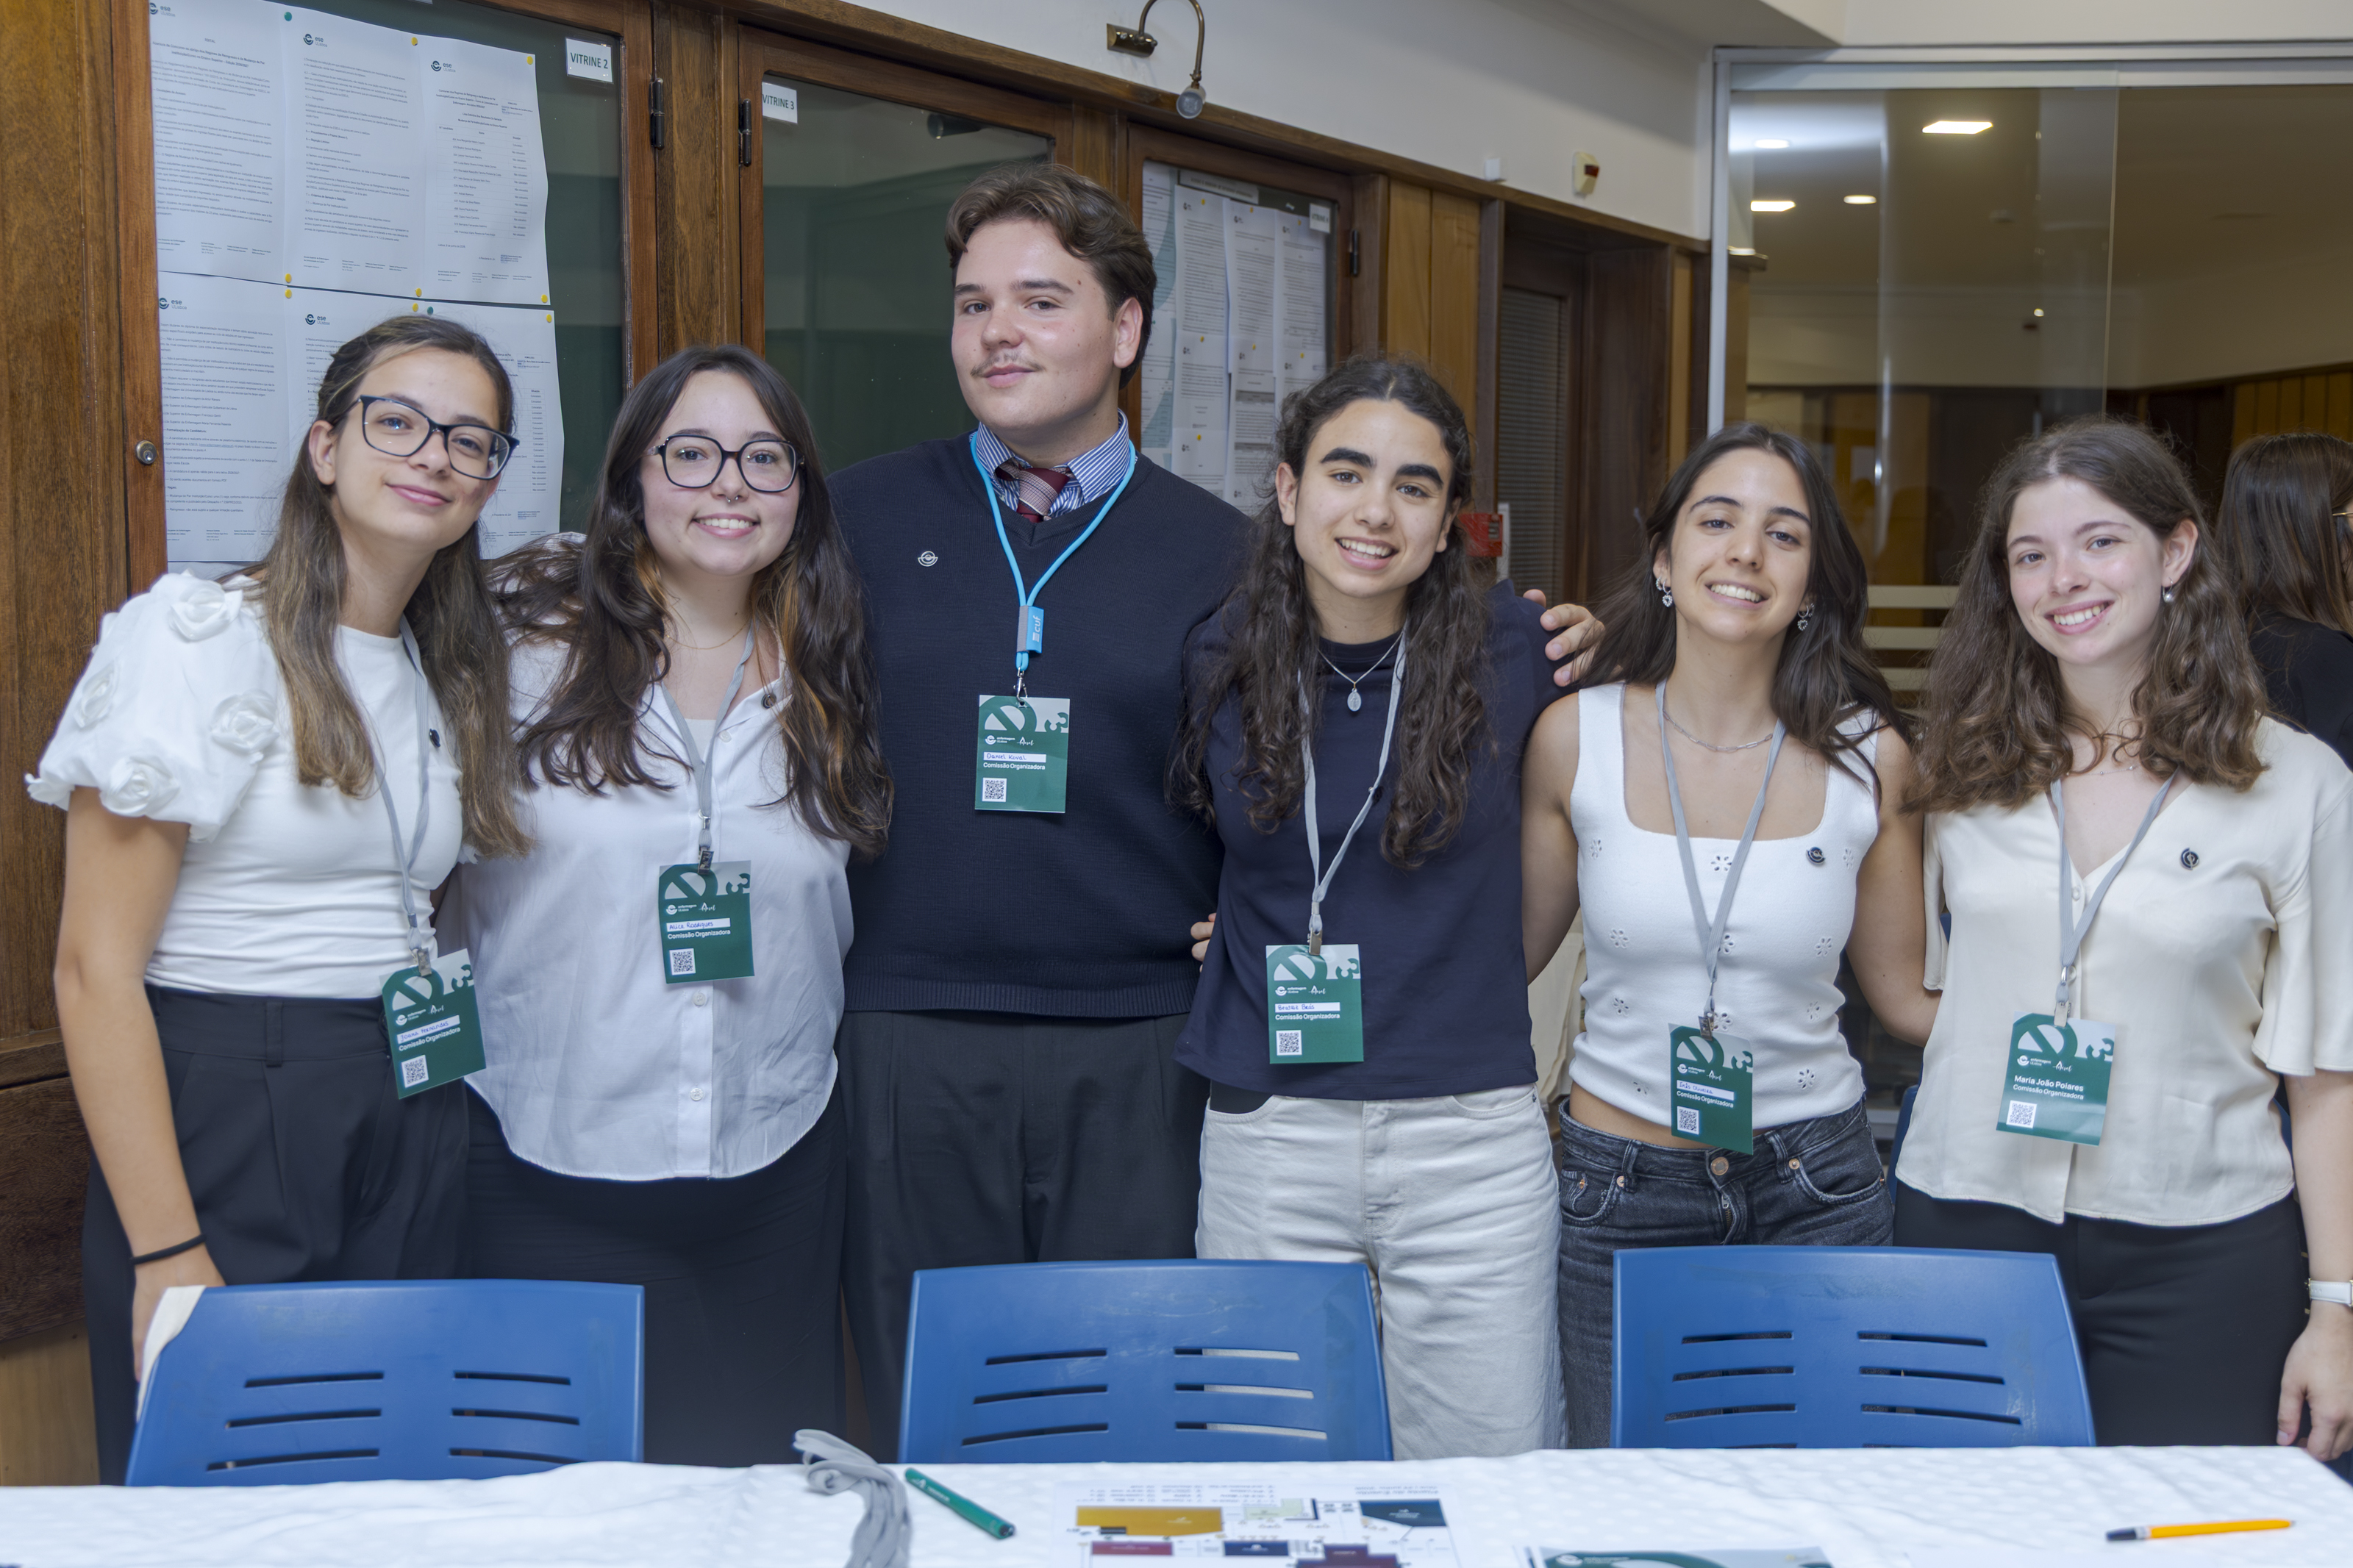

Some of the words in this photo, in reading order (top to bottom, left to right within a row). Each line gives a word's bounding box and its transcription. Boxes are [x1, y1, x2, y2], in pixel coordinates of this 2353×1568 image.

[571, 52, 601, 68] VITRINE
[604, 59, 608, 69] 2
[763, 93, 789, 109] VITRINE
[790, 101, 794, 110] 3
[1032, 615, 1042, 632] cuf
[668, 931, 694, 939] Comissão
[695, 929, 731, 938] Organizadora
[399, 1039, 425, 1051] Comissão
[426, 1027, 461, 1042] Organizadora
[2013, 1084, 2043, 1094] Comissão
[2043, 1089, 2084, 1100] Organizadora
[2014, 1075, 2035, 1085] Maria
[2036, 1078, 2054, 1087] João
[2055, 1081, 2084, 1092] Poiares
[1677, 1091, 1701, 1100] Comissão
[1702, 1096, 1734, 1108] Organizadora
